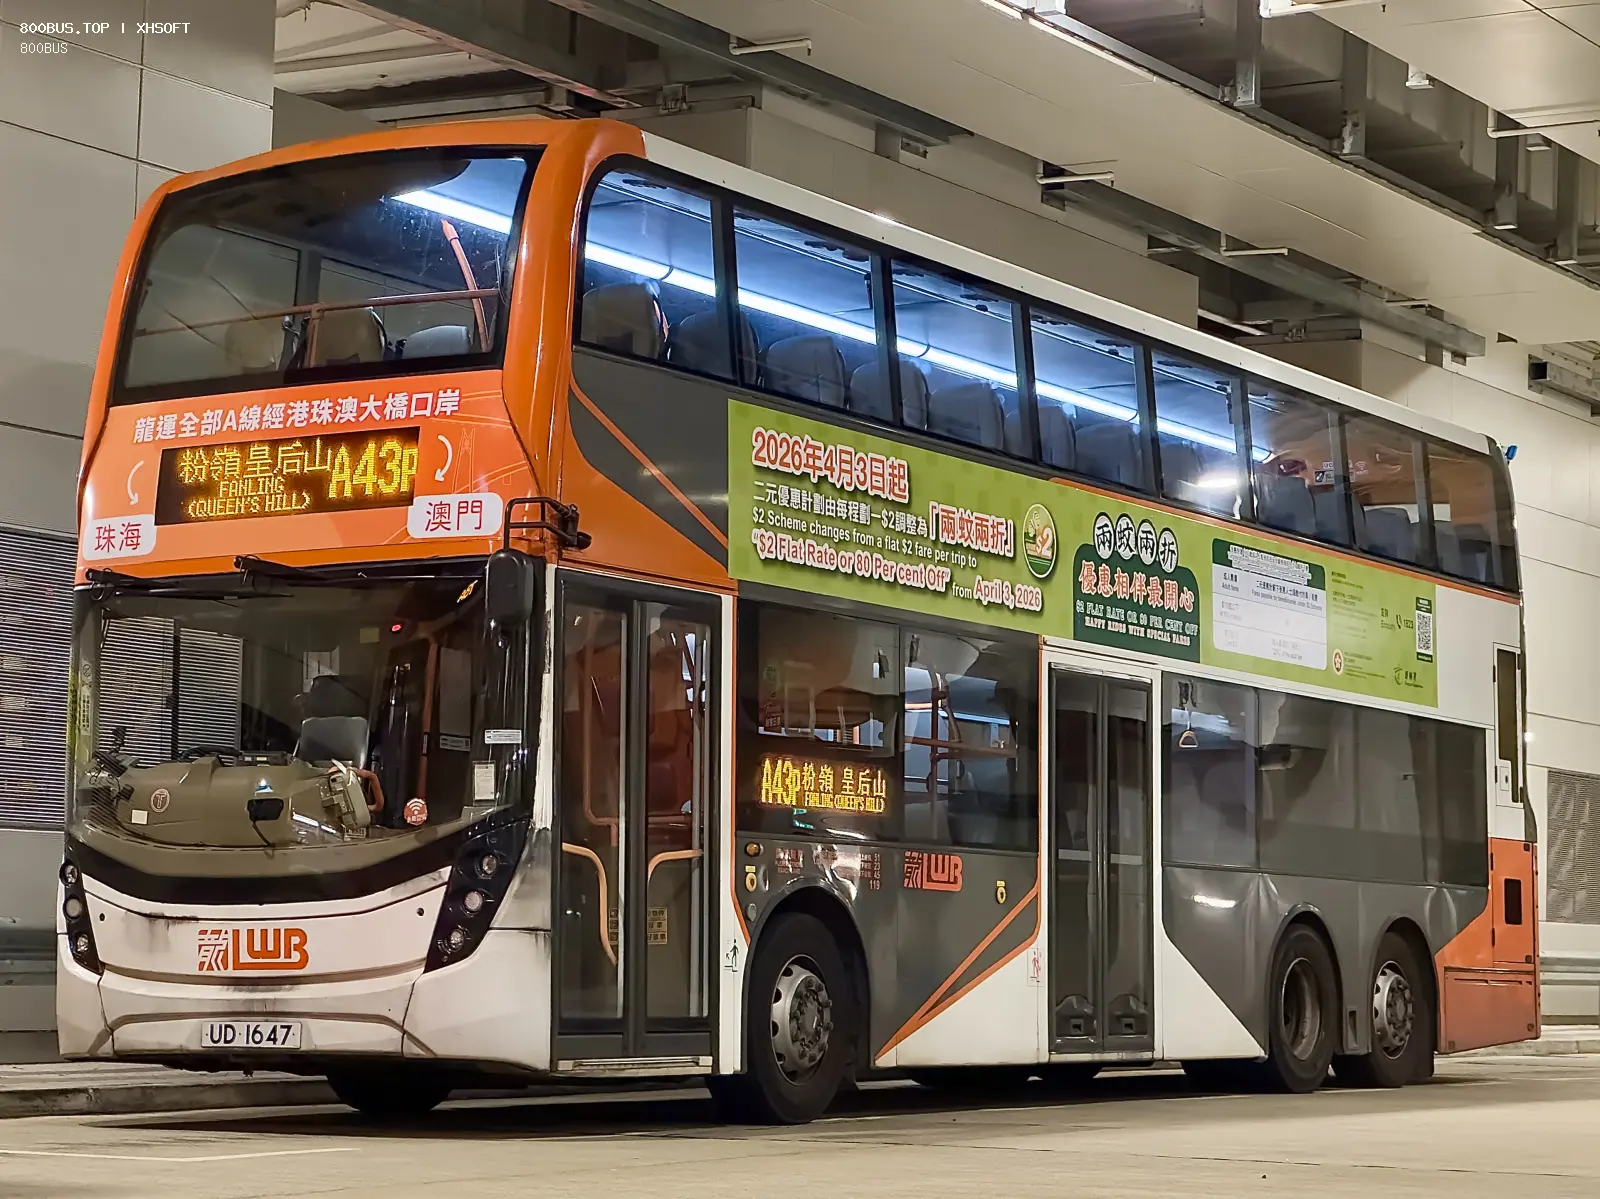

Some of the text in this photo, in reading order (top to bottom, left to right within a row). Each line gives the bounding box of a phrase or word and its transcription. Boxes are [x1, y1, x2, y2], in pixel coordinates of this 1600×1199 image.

[132, 388, 461, 444] 龍運全部A線經港珠澳大橋口岸
[328, 439, 419, 499] A43P
[753, 429, 908, 501] 2026年4月3日起
[219, 476, 286, 498] FANLING
[264, 491, 312, 513] HILL)
[424, 500, 483, 533] 澳門
[94, 521, 143, 553] 珠海
[753, 506, 977, 568] $2 Scheme changes from a flat $2 fare per trip to
[778, 536, 804, 562] Flat
[806, 541, 837, 568] Rate
[839, 552, 854, 571] or
[855, 552, 871, 575] 80
[873, 555, 895, 579] Per
[898, 563, 925, 586] cent
[952, 581, 972, 599] from
[974, 577, 1001, 603] April
[1003, 583, 1014, 607] 3,
[1016, 585, 1041, 609] 2026
[1079, 560, 1195, 612] 優惠相伴最開心
[1085, 616, 1106, 630] HAPPY
[1128, 624, 1145, 637] WITH
[1086, 602, 1104, 616] FLAT
[1106, 606, 1124, 621] RATE
[1127, 610, 1138, 624] OR
[1149, 615, 1163, 629] PER
[1165, 618, 1183, 633] CENT
[232, 928, 309, 971] LWB
[209, 1023, 293, 1046] UD 1647
